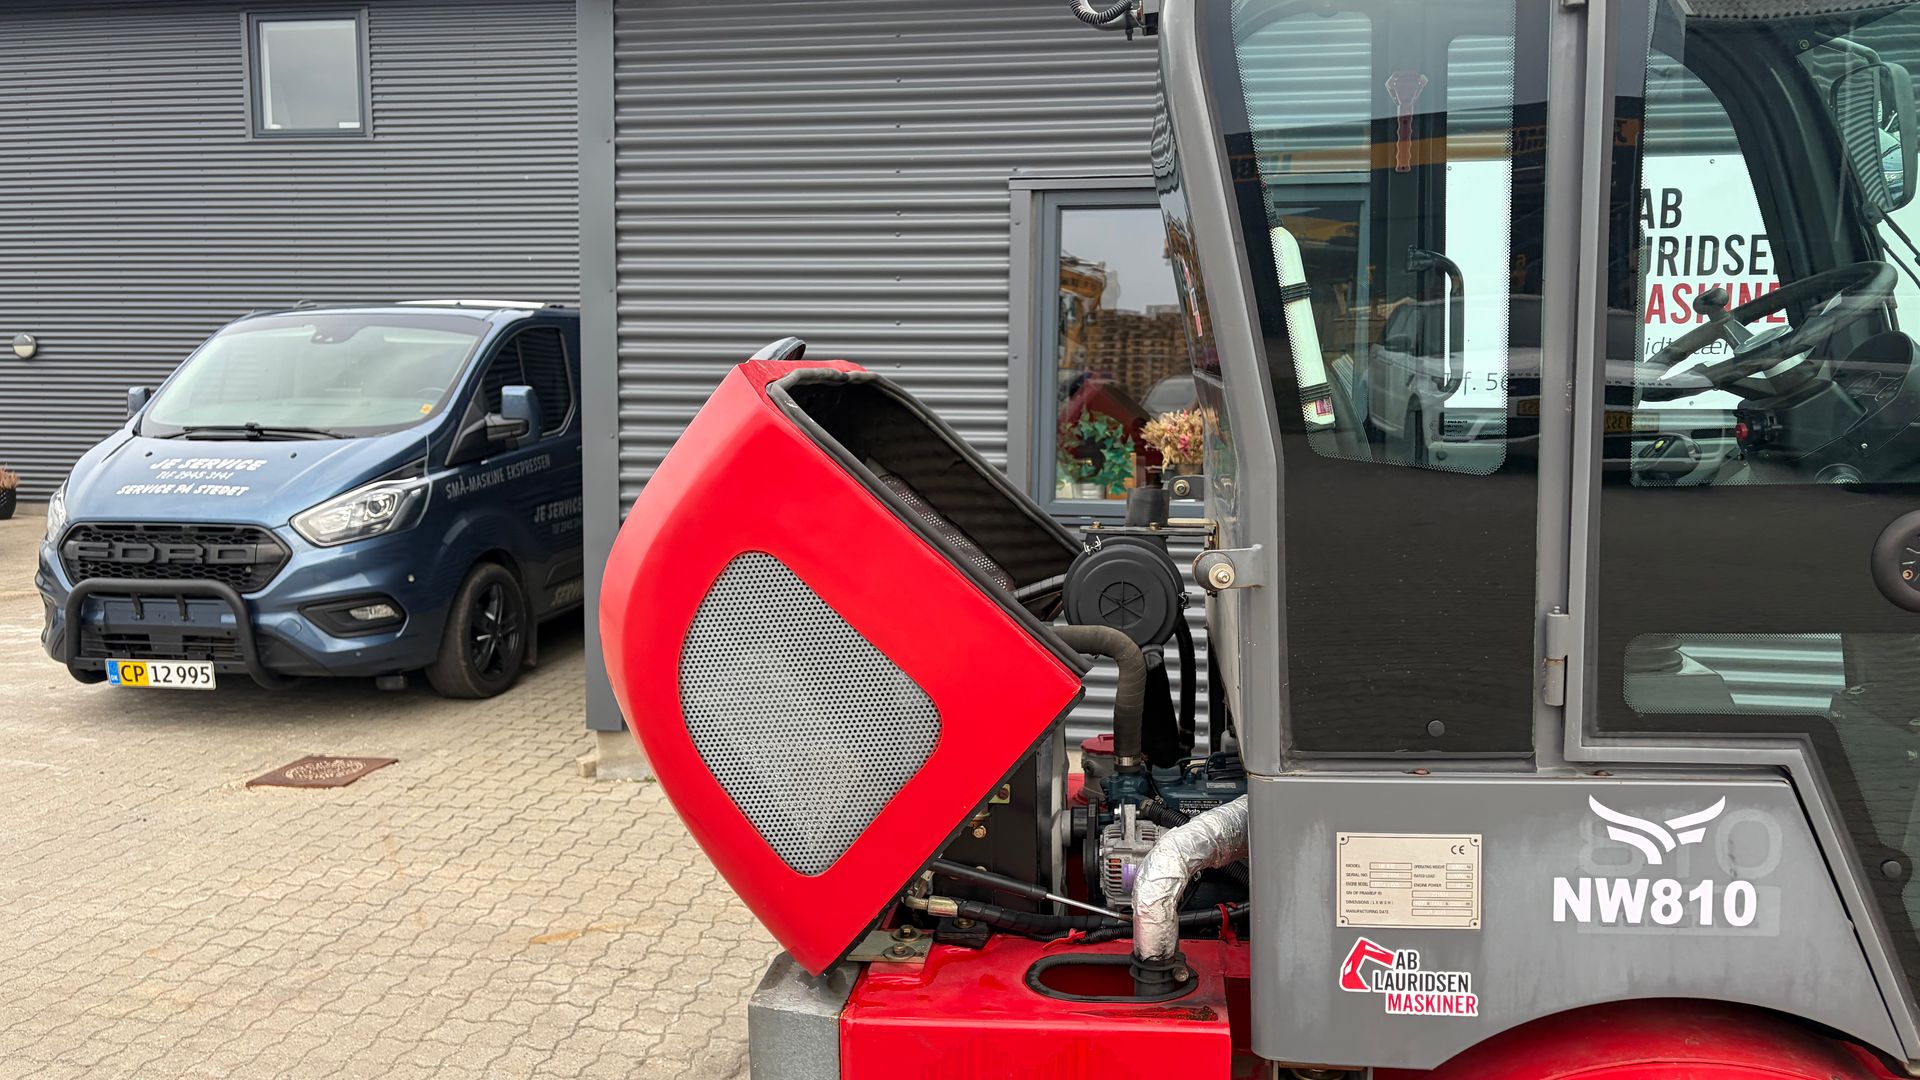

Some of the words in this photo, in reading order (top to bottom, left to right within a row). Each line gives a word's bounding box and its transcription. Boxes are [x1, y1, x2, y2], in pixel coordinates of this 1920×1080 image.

[1641, 187, 1683, 229] AB
[1645, 234, 1777, 277] RIDSE
[150, 458, 182, 470] JE
[180, 458, 267, 471] SERVICE
[116, 484, 176, 496] SERVICE
[193, 484, 250, 497] STEDET
[547, 496, 583, 520] SERVICE
[120, 664, 145, 683] CP
[150, 665, 173, 683] 12
[176, 666, 211, 685] 995
[1553, 876, 1757, 927] NW810
[1396, 951, 1418, 970] AB
[1374, 972, 1469, 993] LAURIDSEN
[1387, 993, 1477, 1014] MASKINER
